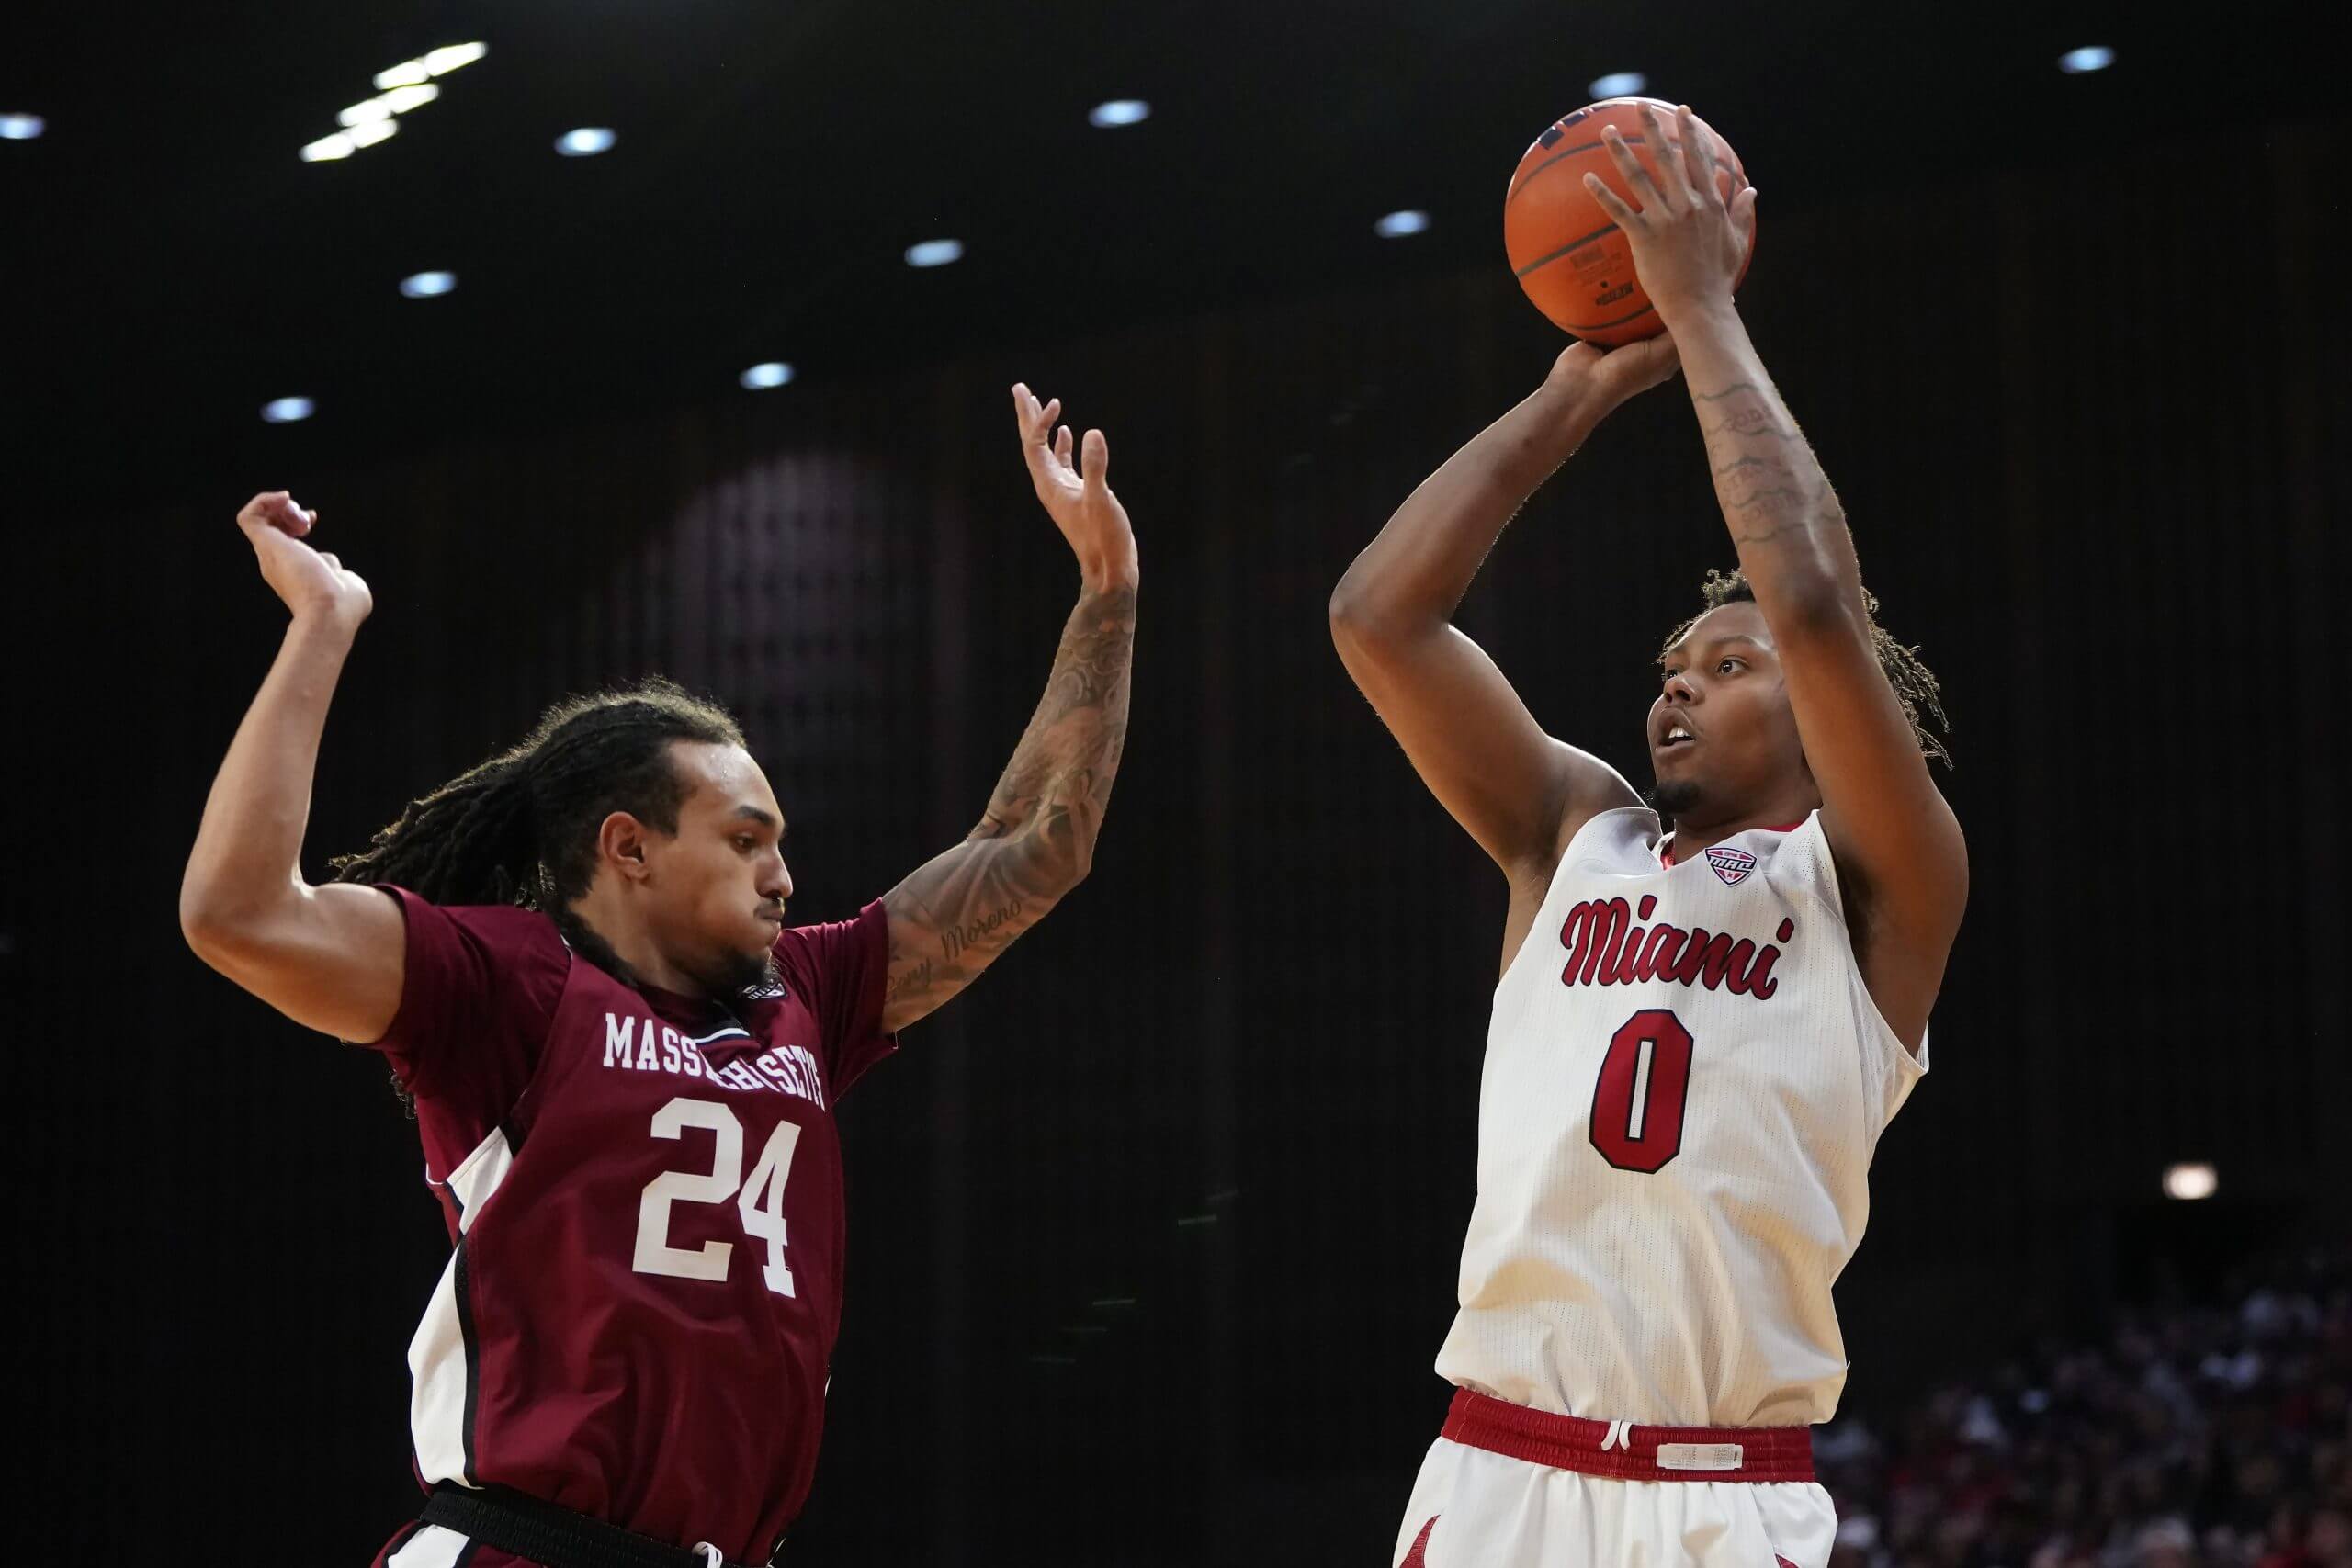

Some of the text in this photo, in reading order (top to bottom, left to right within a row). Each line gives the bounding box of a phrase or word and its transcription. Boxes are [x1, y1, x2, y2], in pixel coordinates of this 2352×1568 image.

[940, 899, 1023, 962] Moreno
[1560, 894, 1794, 1000] Miami
[603, 1012, 826, 1112] MASSHSETT
[1589, 1009, 1694, 1175] 0
[632, 1096, 802, 1299] 24
